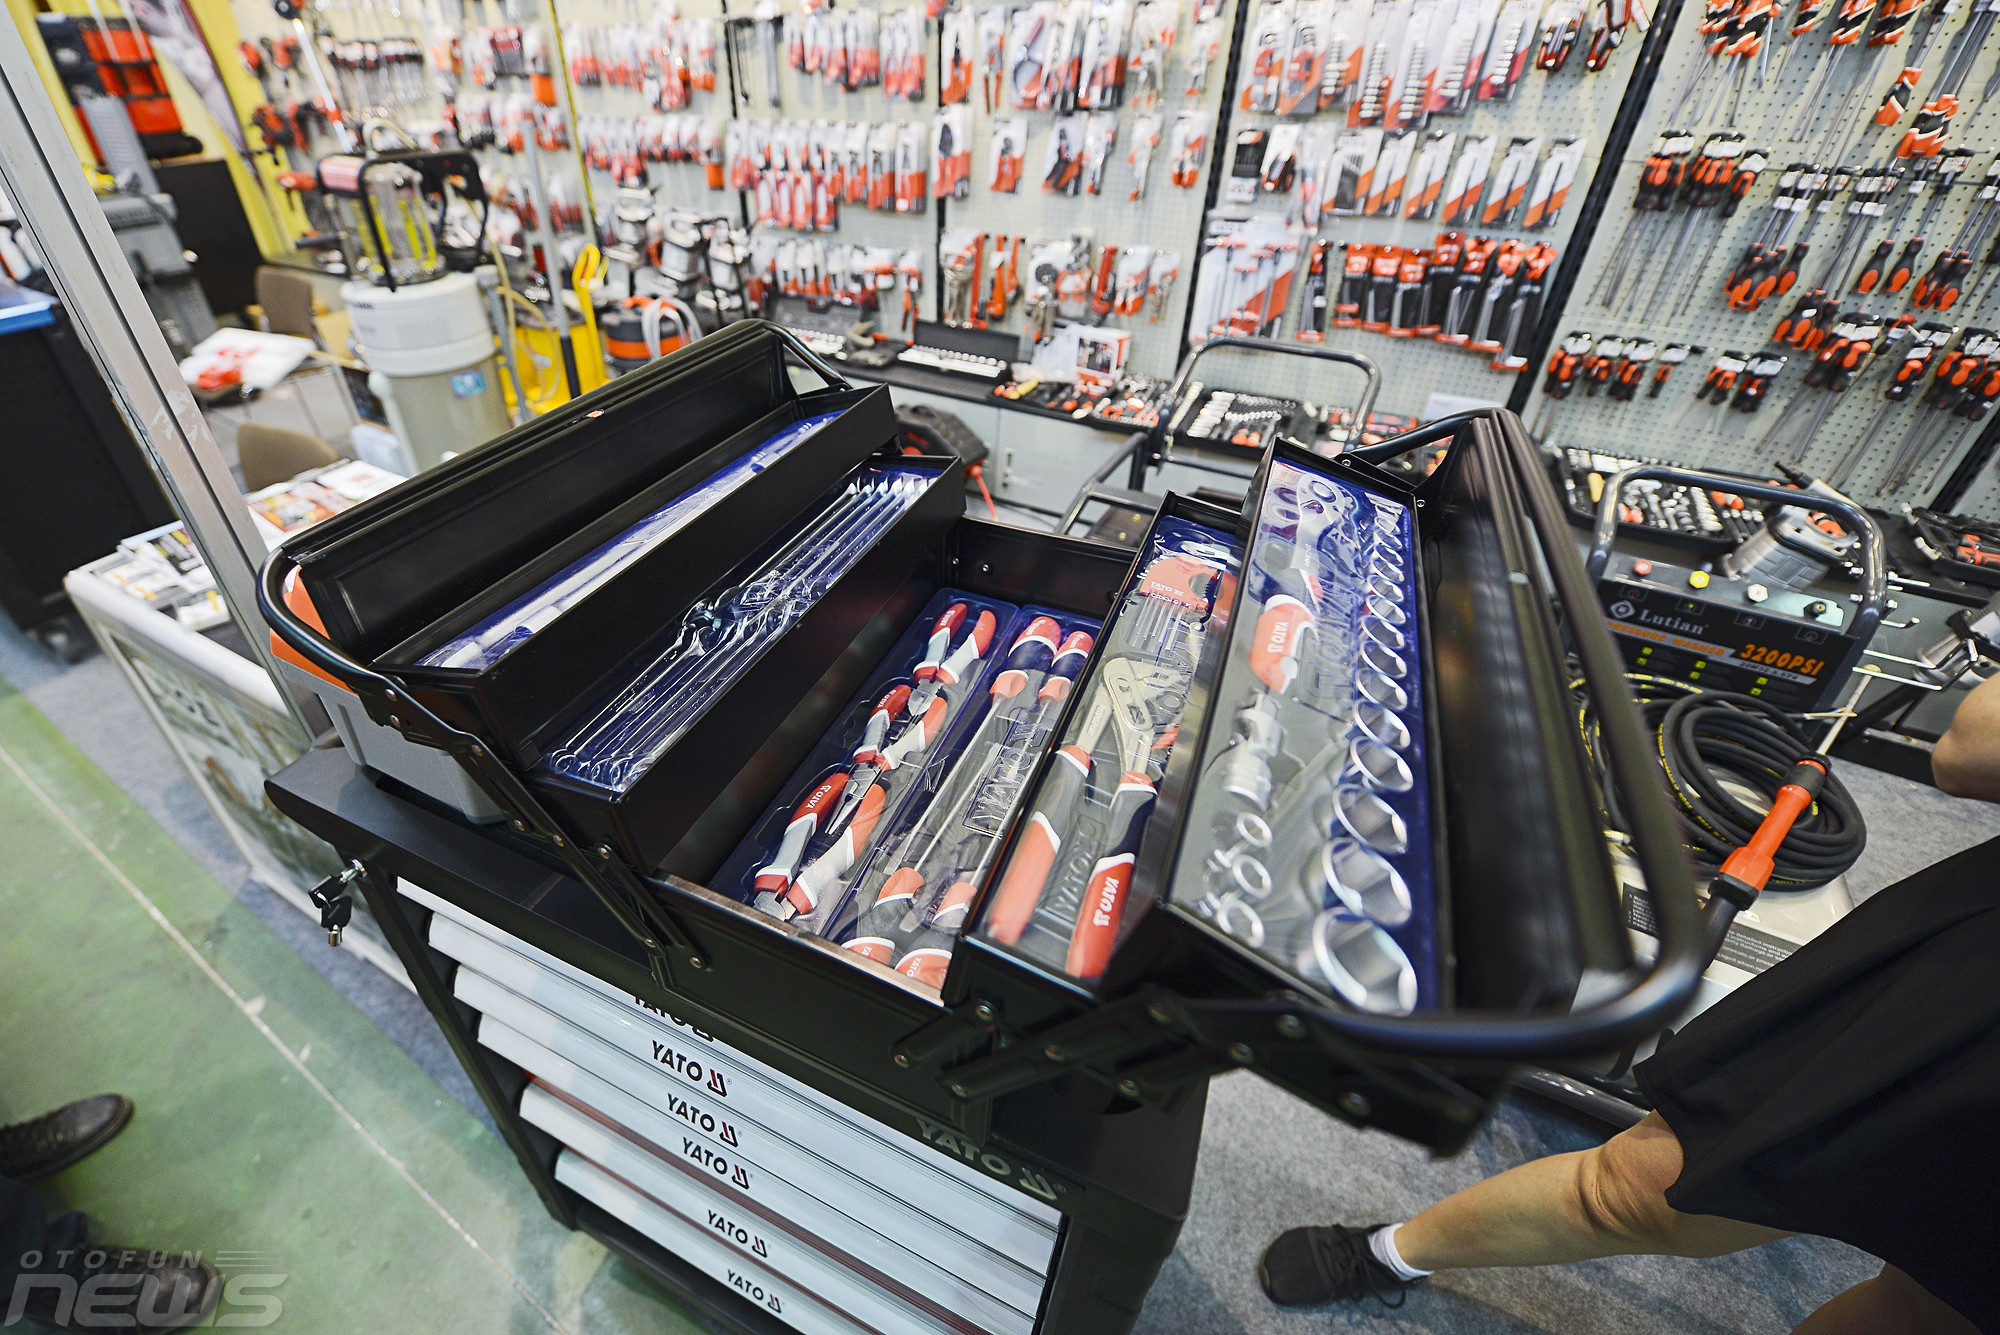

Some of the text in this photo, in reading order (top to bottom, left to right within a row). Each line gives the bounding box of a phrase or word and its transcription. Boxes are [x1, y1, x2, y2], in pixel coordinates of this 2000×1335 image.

[1151, 580, 1173, 592] YATO
[1274, 620, 1289, 647] YATO
[1639, 608, 1705, 636] Lutian
[1671, 636, 1725, 656] WASHER
[1740, 643, 1826, 677] 3200PSI
[805, 790, 824, 810] YATO
[1100, 876, 1121, 914] YATO
[906, 957, 922, 978] YATO
[652, 1040, 703, 1082] YATO
[667, 1092, 715, 1132] YATO
[682, 1136, 728, 1175] YATO
[916, 1118, 1012, 1176] YATO
[707, 1209, 748, 1244] YATO
[727, 1269, 764, 1301] YATO
